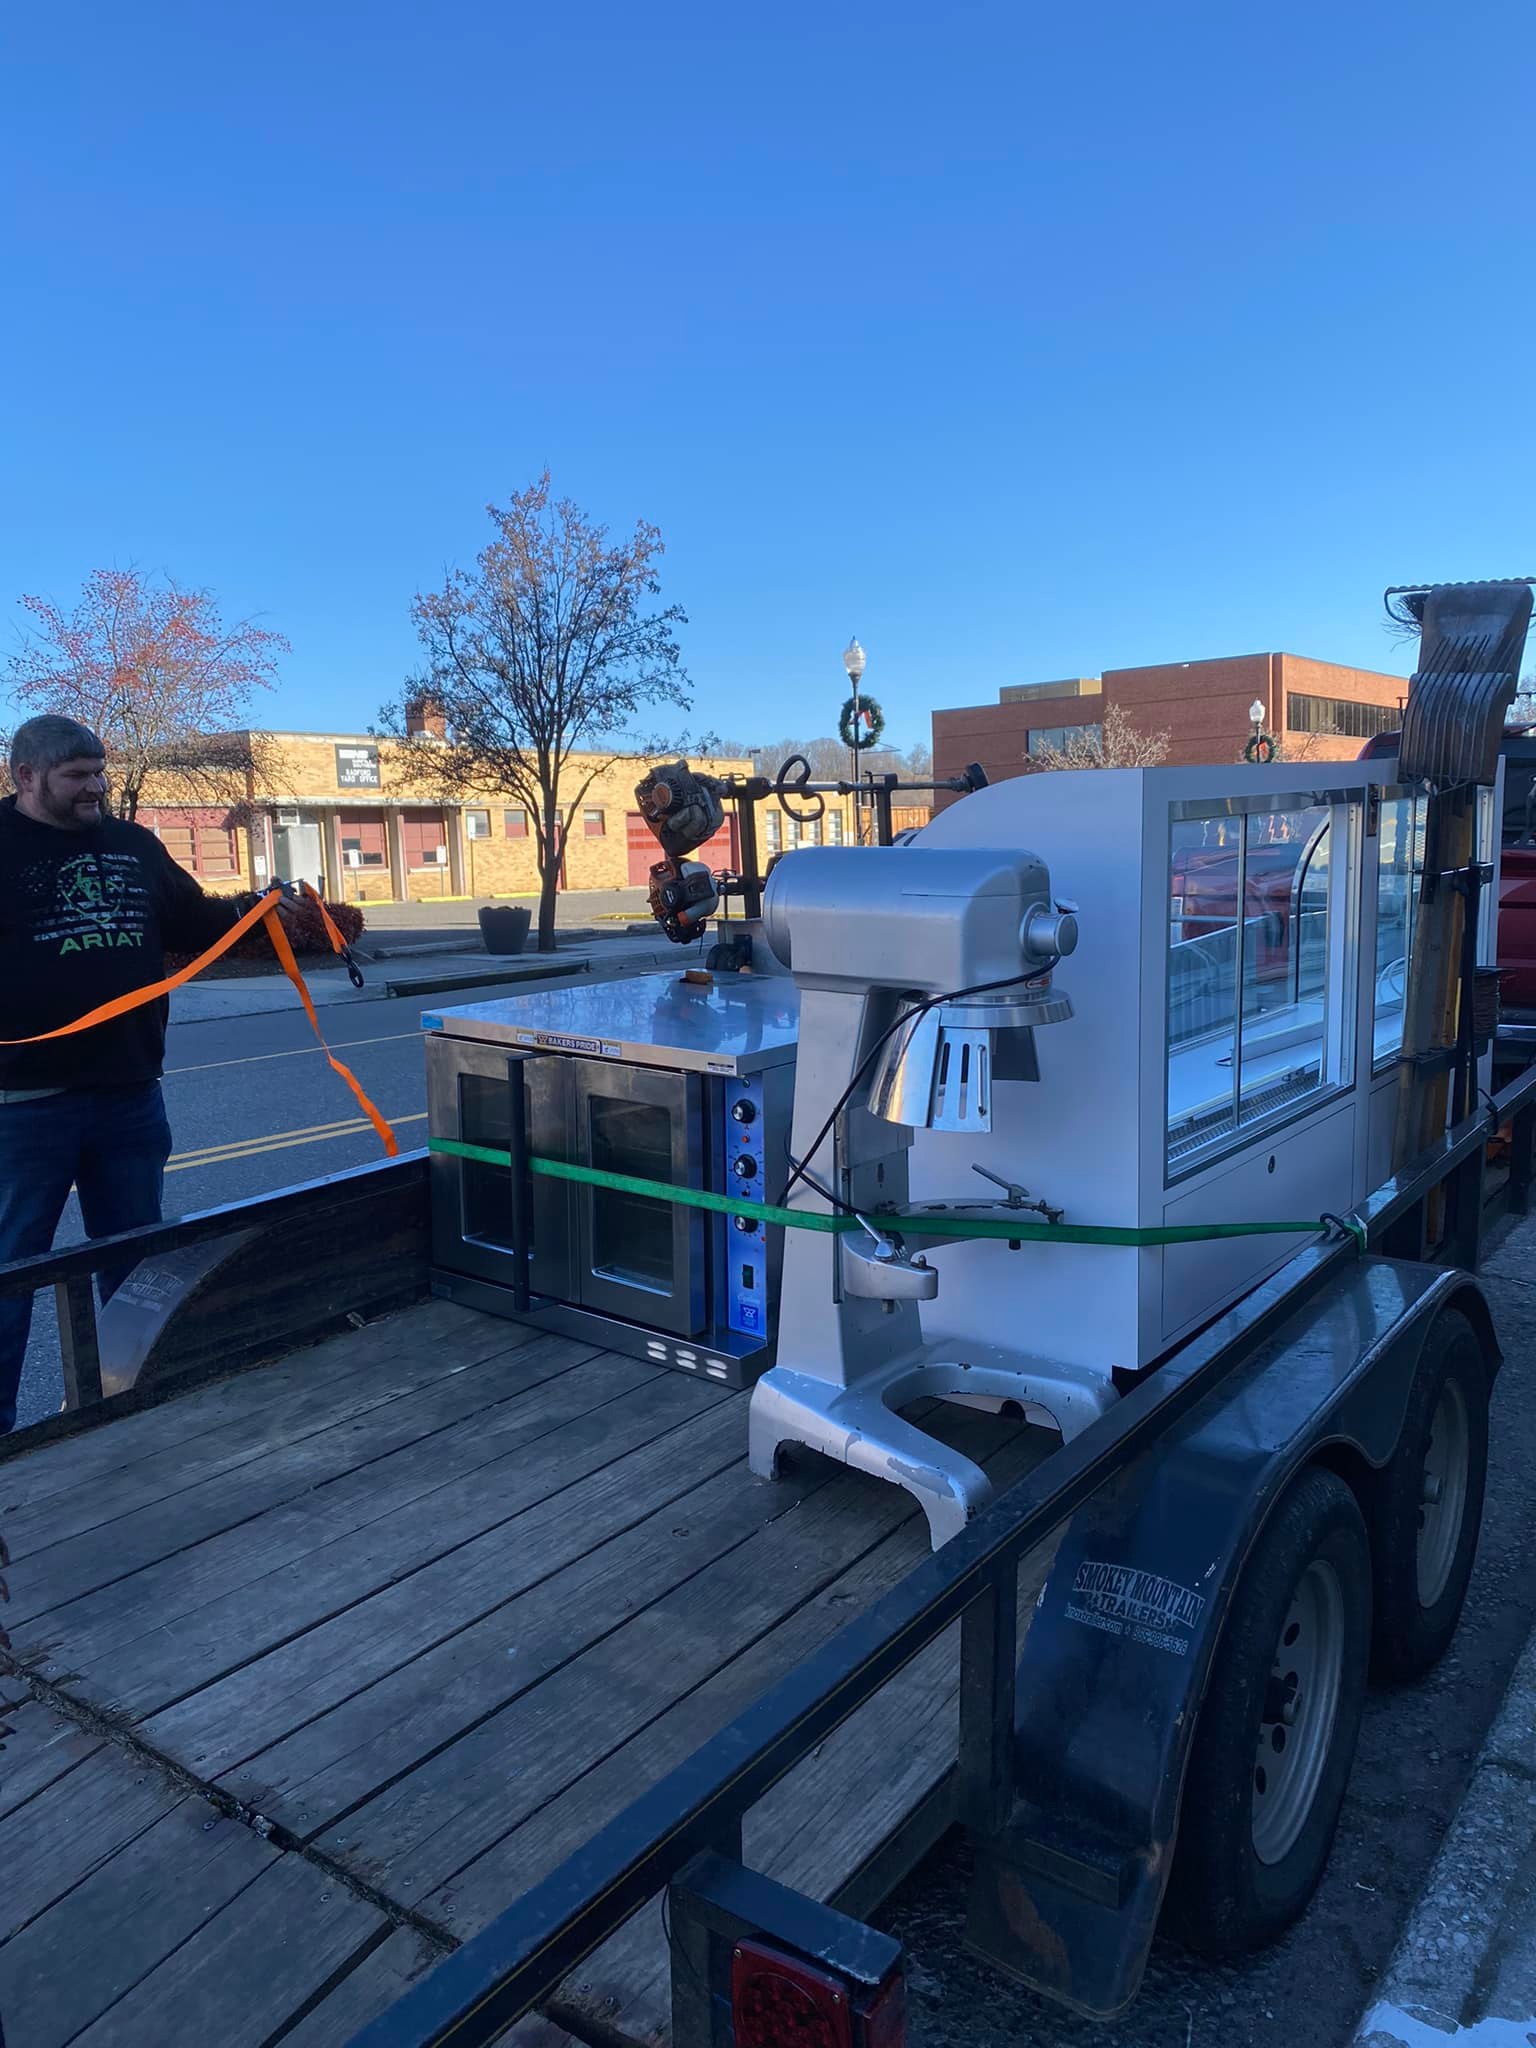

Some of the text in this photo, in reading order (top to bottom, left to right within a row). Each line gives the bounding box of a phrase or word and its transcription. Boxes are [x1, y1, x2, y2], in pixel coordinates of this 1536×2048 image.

[60, 931, 144, 955] ARIAT
[548, 1034, 576, 1048] BAKERS
[576, 1039, 596, 1051] PRIDE
[1073, 1561, 1205, 1628] SMOKEY MOUNTAIN
[1098, 1595, 1166, 1629] TRAILERS
